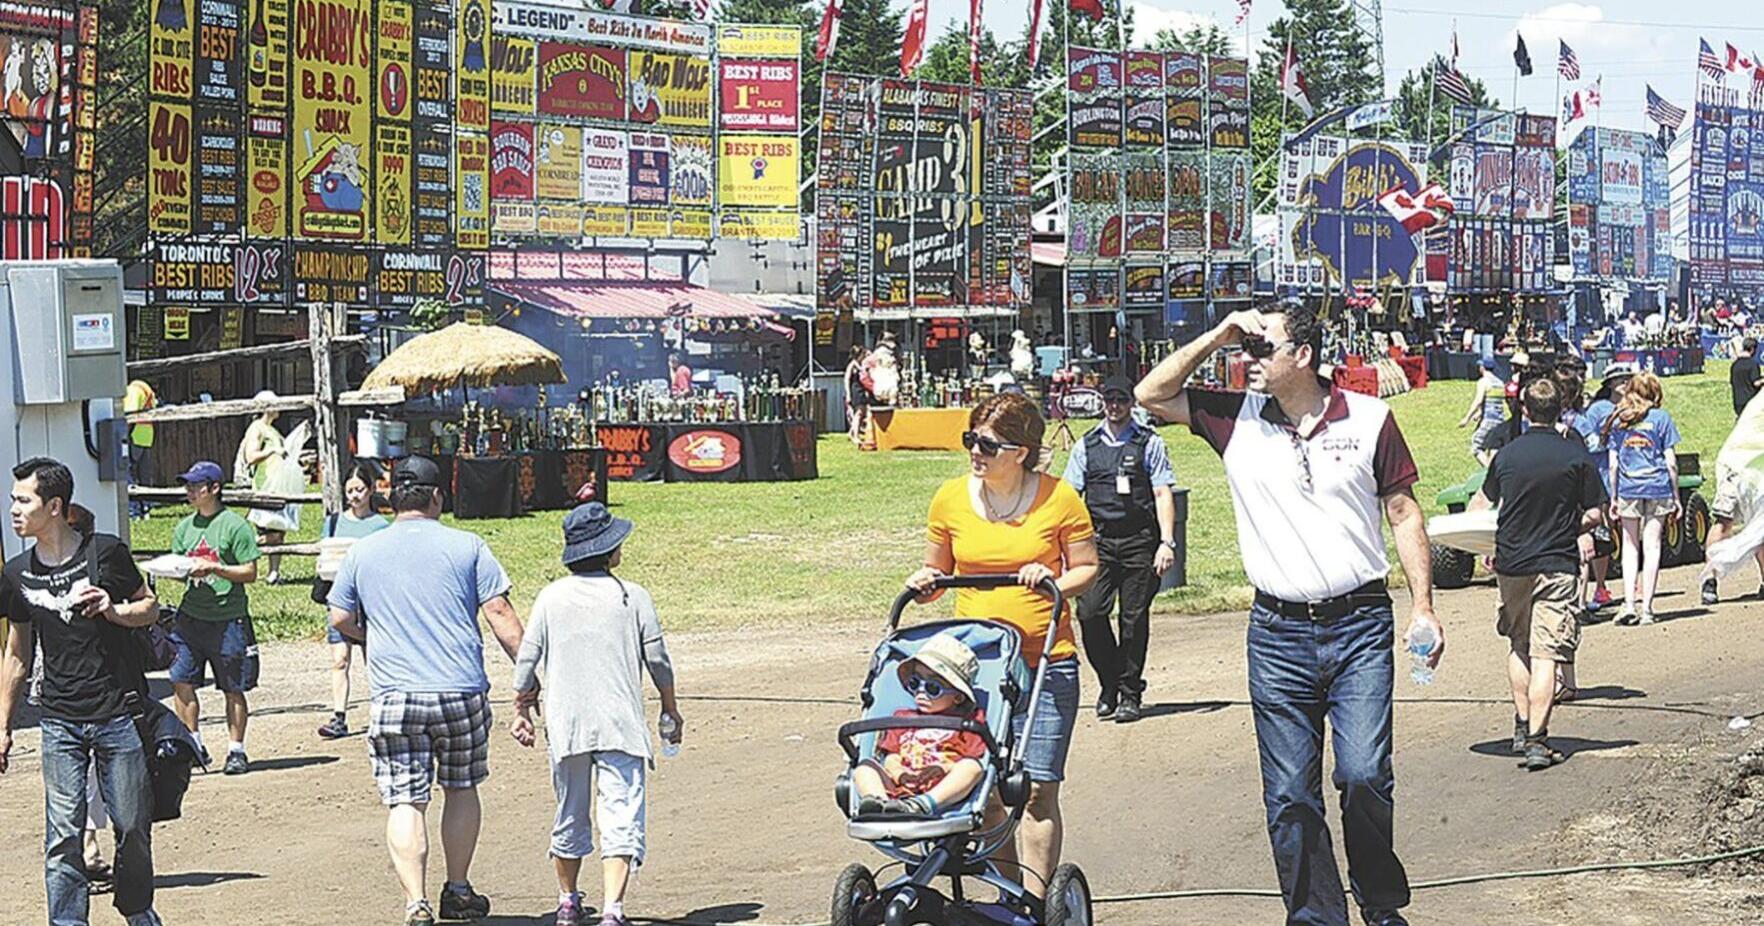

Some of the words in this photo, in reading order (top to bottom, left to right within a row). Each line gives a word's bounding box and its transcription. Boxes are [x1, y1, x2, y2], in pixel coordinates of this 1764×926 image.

[201, 1, 238, 18] CORNWALL
[202, 15, 217, 25] 2012
[222, 18, 237, 27] 2013
[380, 20, 411, 41] CRABBY'S
[296, 0, 369, 68] CRABBY'S
[587, 17, 608, 36] Best
[610, 20, 630, 38] Ribs
[631, 22, 642, 38] In
[644, 25, 668, 43] North
[670, 28, 705, 46] America
[201, 25, 237, 60] BEST
[153, 60, 190, 95] RIBS
[209, 73, 228, 84] SAUCE
[541, 52, 588, 92] KANSAS
[589, 53, 624, 100] CITY'S
[641, 54, 670, 89] BAD
[671, 57, 709, 90] WOLF
[723, 64, 759, 80] BEST
[760, 65, 794, 81] RIBS
[201, 85, 220, 97] PULLED
[221, 87, 236, 98] PORK
[302, 69, 362, 105] B.B.Q.
[418, 69, 448, 100] BEST
[756, 100, 784, 108] PLACE
[883, 87, 928, 104] ALABAMA'S
[929, 92, 958, 108] FINEST
[417, 101, 448, 118] OVERALL
[664, 98, 709, 119] BARBECUE
[1072, 106, 1120, 128] BURLINGTON
[315, 108, 351, 134] SHACK
[887, 118, 914, 131] BBQ
[917, 119, 945, 133] RIBS
[151, 106, 190, 165] 40
[201, 149, 218, 164] BEST
[219, 149, 236, 165] RIBS
[724, 142, 758, 156] BEST
[762, 143, 793, 157] RIBS
[153, 168, 188, 198] TONS
[538, 169, 579, 180] CORNBREAD
[876, 156, 941, 219] CAMP
[942, 118, 984, 231] 31
[201, 178, 215, 194] BEST
[216, 179, 236, 195] SAUCE
[165, 202, 189, 214] EVERY
[201, 205, 215, 221] BEST
[499, 206, 518, 217] BEST
[519, 207, 534, 218] BBQ
[636, 211, 652, 221] BEST
[1352, 222, 1392, 239] BAR-B-Q
[159, 244, 232, 262] TORONTO'S
[890, 242, 911, 260] THE
[914, 233, 948, 251] HEART
[914, 254, 935, 268] OF
[935, 243, 964, 263] DIXIE
[294, 251, 369, 282] CHAMPIONSHIP
[383, 253, 442, 271] CORNWALL
[155, 263, 197, 288] BEST
[201, 264, 235, 288] RIBS
[379, 271, 414, 293] BEST
[416, 272, 445, 294] RIBS
[166, 290, 199, 300] PEOPLE'S
[200, 290, 225, 300] CHOICE
[308, 284, 329, 300] BBQ
[333, 285, 357, 301] TEAM
